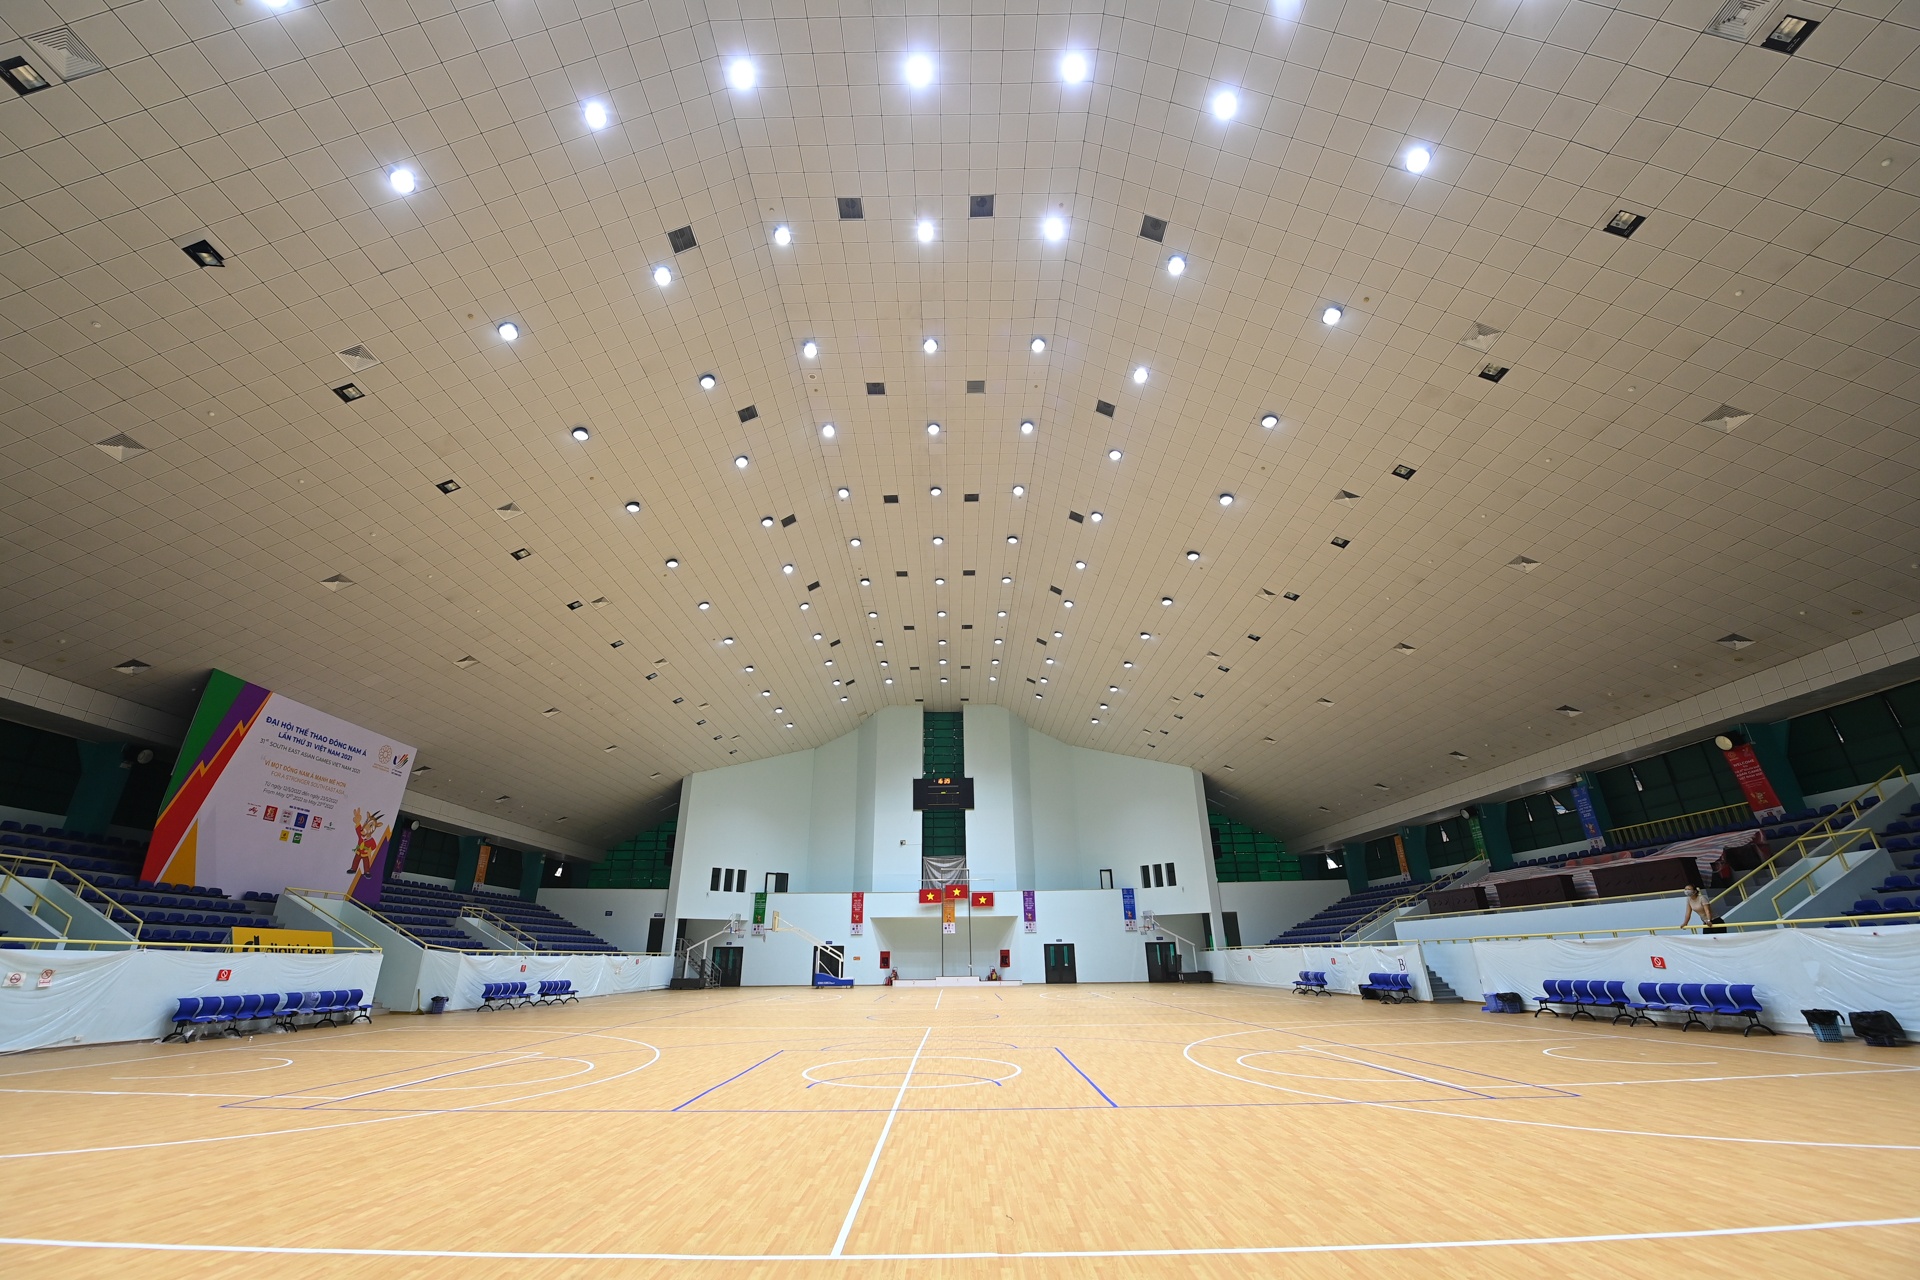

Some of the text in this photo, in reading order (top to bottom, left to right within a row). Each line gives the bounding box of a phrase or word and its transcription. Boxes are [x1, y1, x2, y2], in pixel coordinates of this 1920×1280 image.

[266, 716, 280, 727] ĐẠI
[280, 722, 294, 731] HỘI
[296, 726, 309, 736] THỂ
[310, 732, 328, 742] THAO
[328, 738, 347, 750] ĐÔNG
[348, 745, 362, 754] NAM
[270, 741, 287, 751] SOUTH
[300, 751, 315, 760] ASIAN
[316, 756, 332, 765] GAMES
[278, 732, 292, 741] LẦN
[293, 736, 306, 745] THỨ
[314, 744, 327, 752] VIỆT
[327, 748, 340, 757] NAM
[341, 753, 353, 761] 2021
[1733, 759, 1755, 767] WELCOME
[286, 775, 310, 785] STRONGER
[1398, 959, 1405, 971] B
